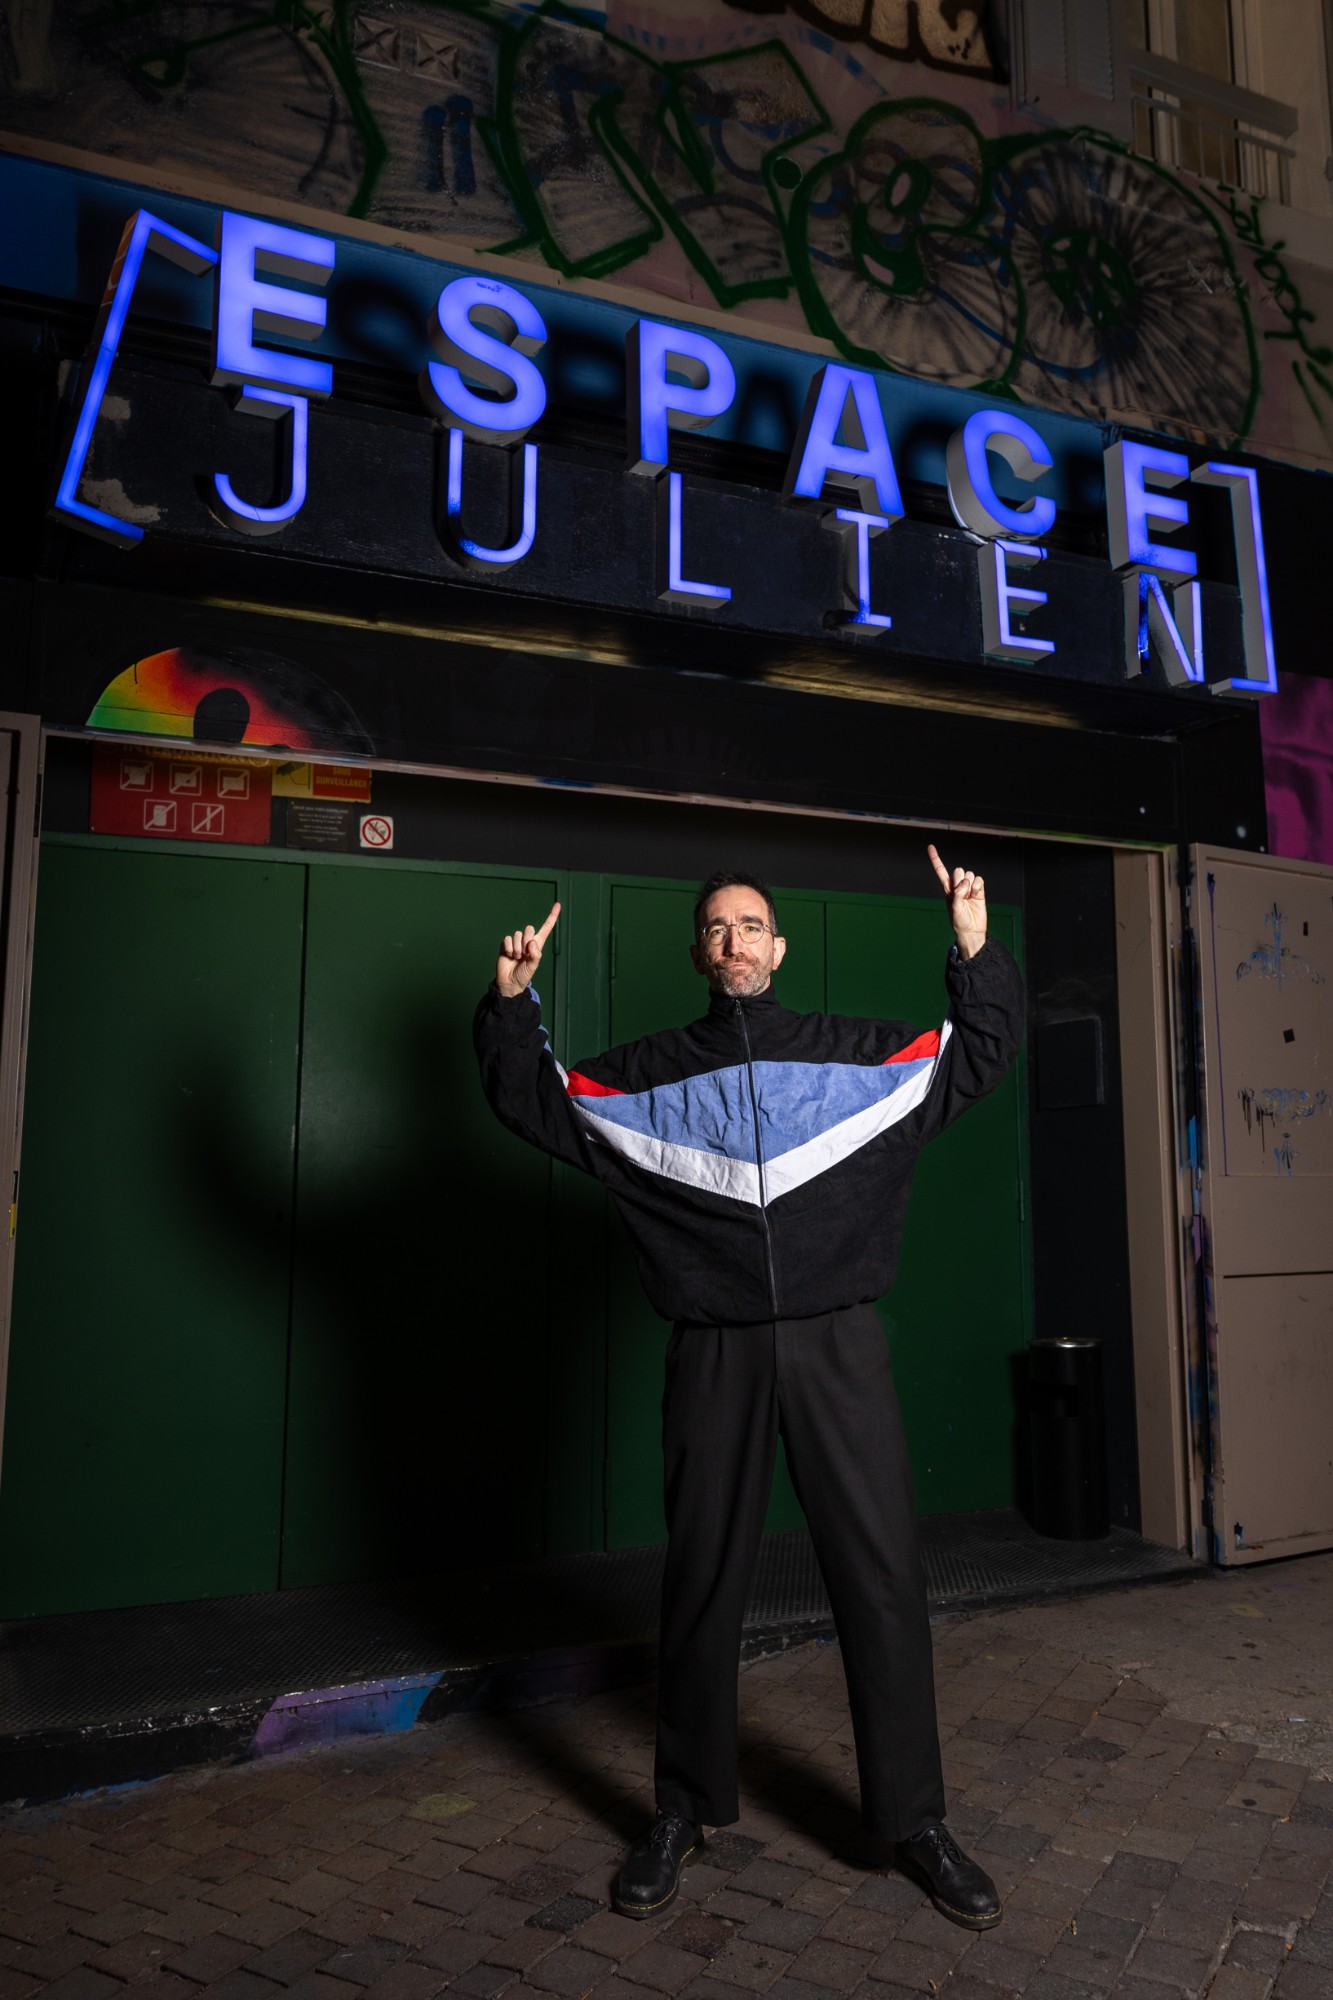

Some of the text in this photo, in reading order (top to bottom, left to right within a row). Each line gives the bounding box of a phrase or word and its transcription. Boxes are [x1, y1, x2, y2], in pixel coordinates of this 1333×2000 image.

[213, 210, 1198, 578] ESPACE
[212, 384, 1206, 684] JULIEN
[316, 775, 367, 788] SURVEILLANCE
[332, 766, 352, 776] SOUS
